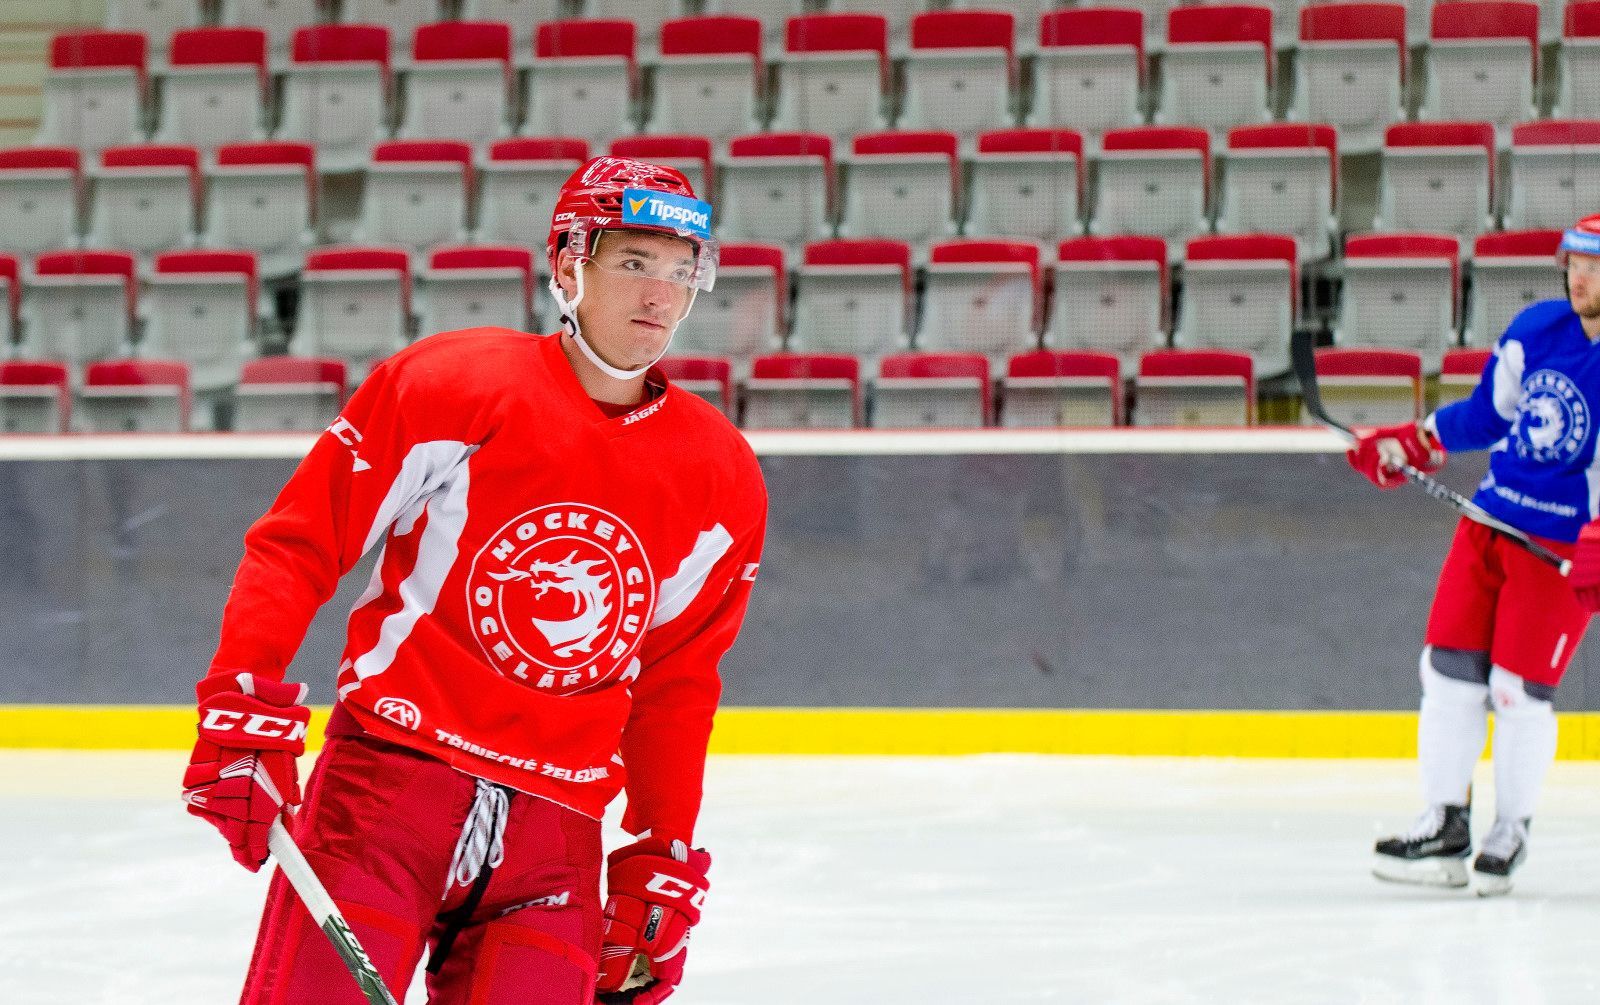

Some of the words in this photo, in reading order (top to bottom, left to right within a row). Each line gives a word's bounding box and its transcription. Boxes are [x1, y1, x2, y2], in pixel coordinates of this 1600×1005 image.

[555, 212, 577, 222] CCM
[649, 199, 709, 229] Tipsport
[491, 512, 633, 561] HOCKEY
[610, 567, 645, 659] CLUB
[475, 586, 599, 688] OCELÁŘI
